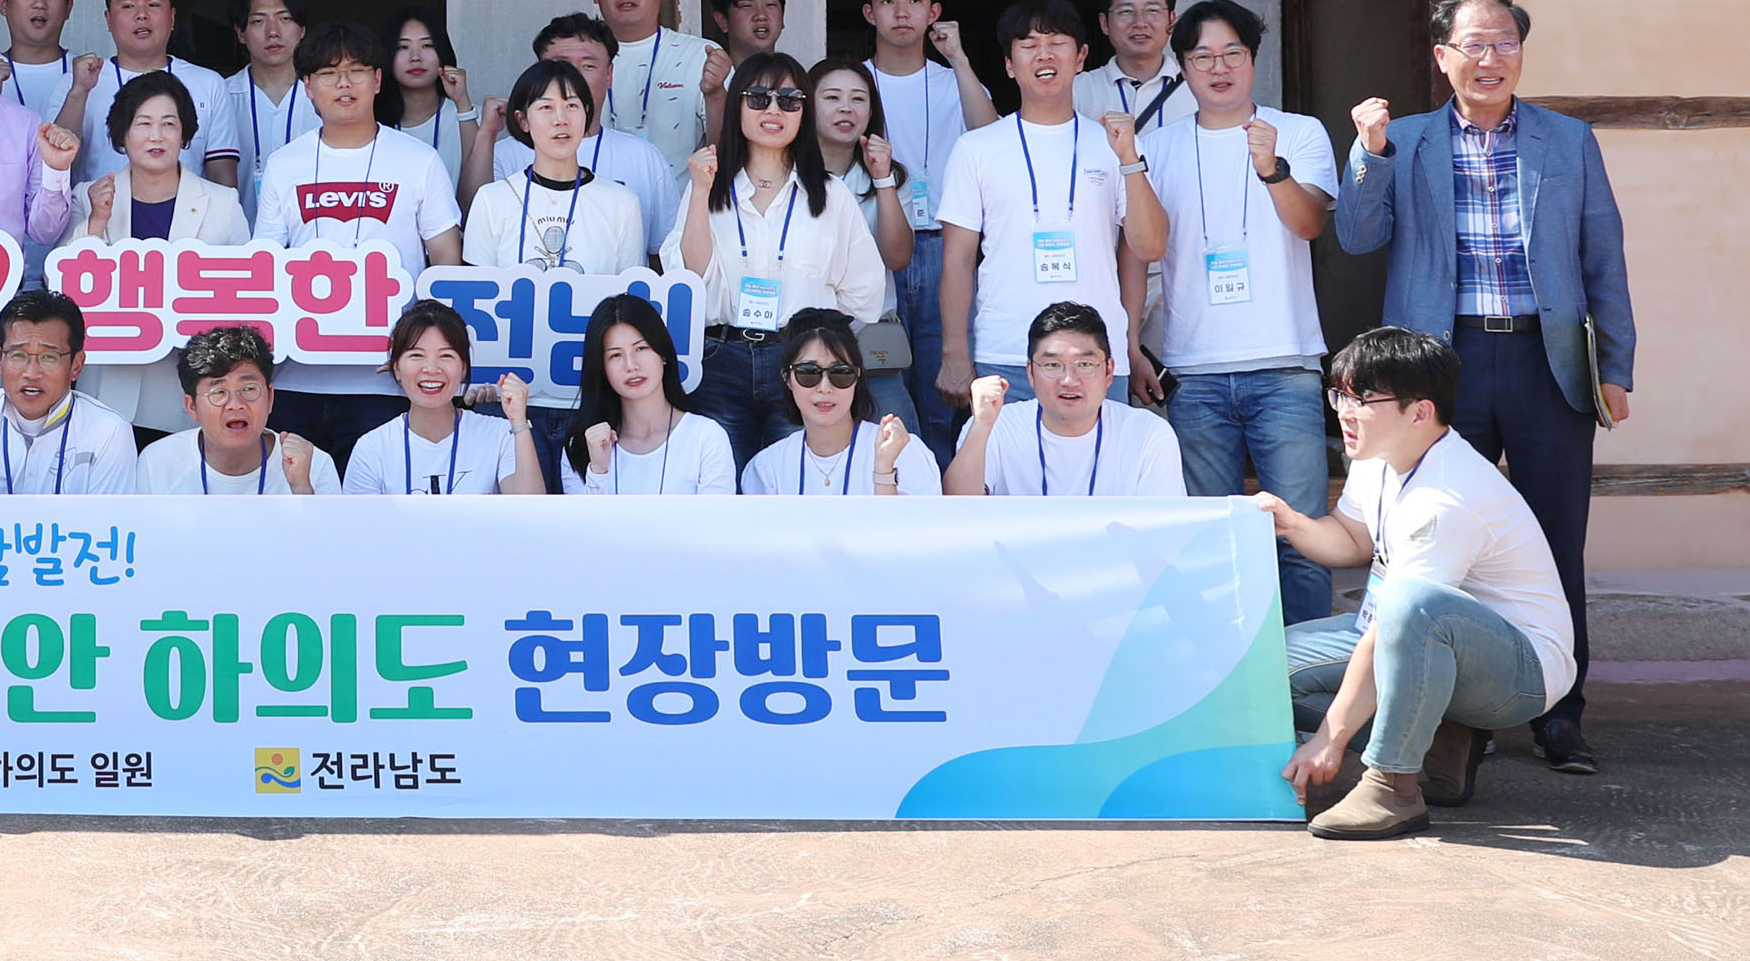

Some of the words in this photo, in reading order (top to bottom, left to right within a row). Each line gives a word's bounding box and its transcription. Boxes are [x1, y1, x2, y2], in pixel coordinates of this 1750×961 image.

[57, 249, 401, 352] 행복한
[139, 610, 474, 724] 하의도
[504, 610, 950, 726] 현장방문
[90, 751, 153, 788] 일원
[310, 751, 461, 790] 전라남도
